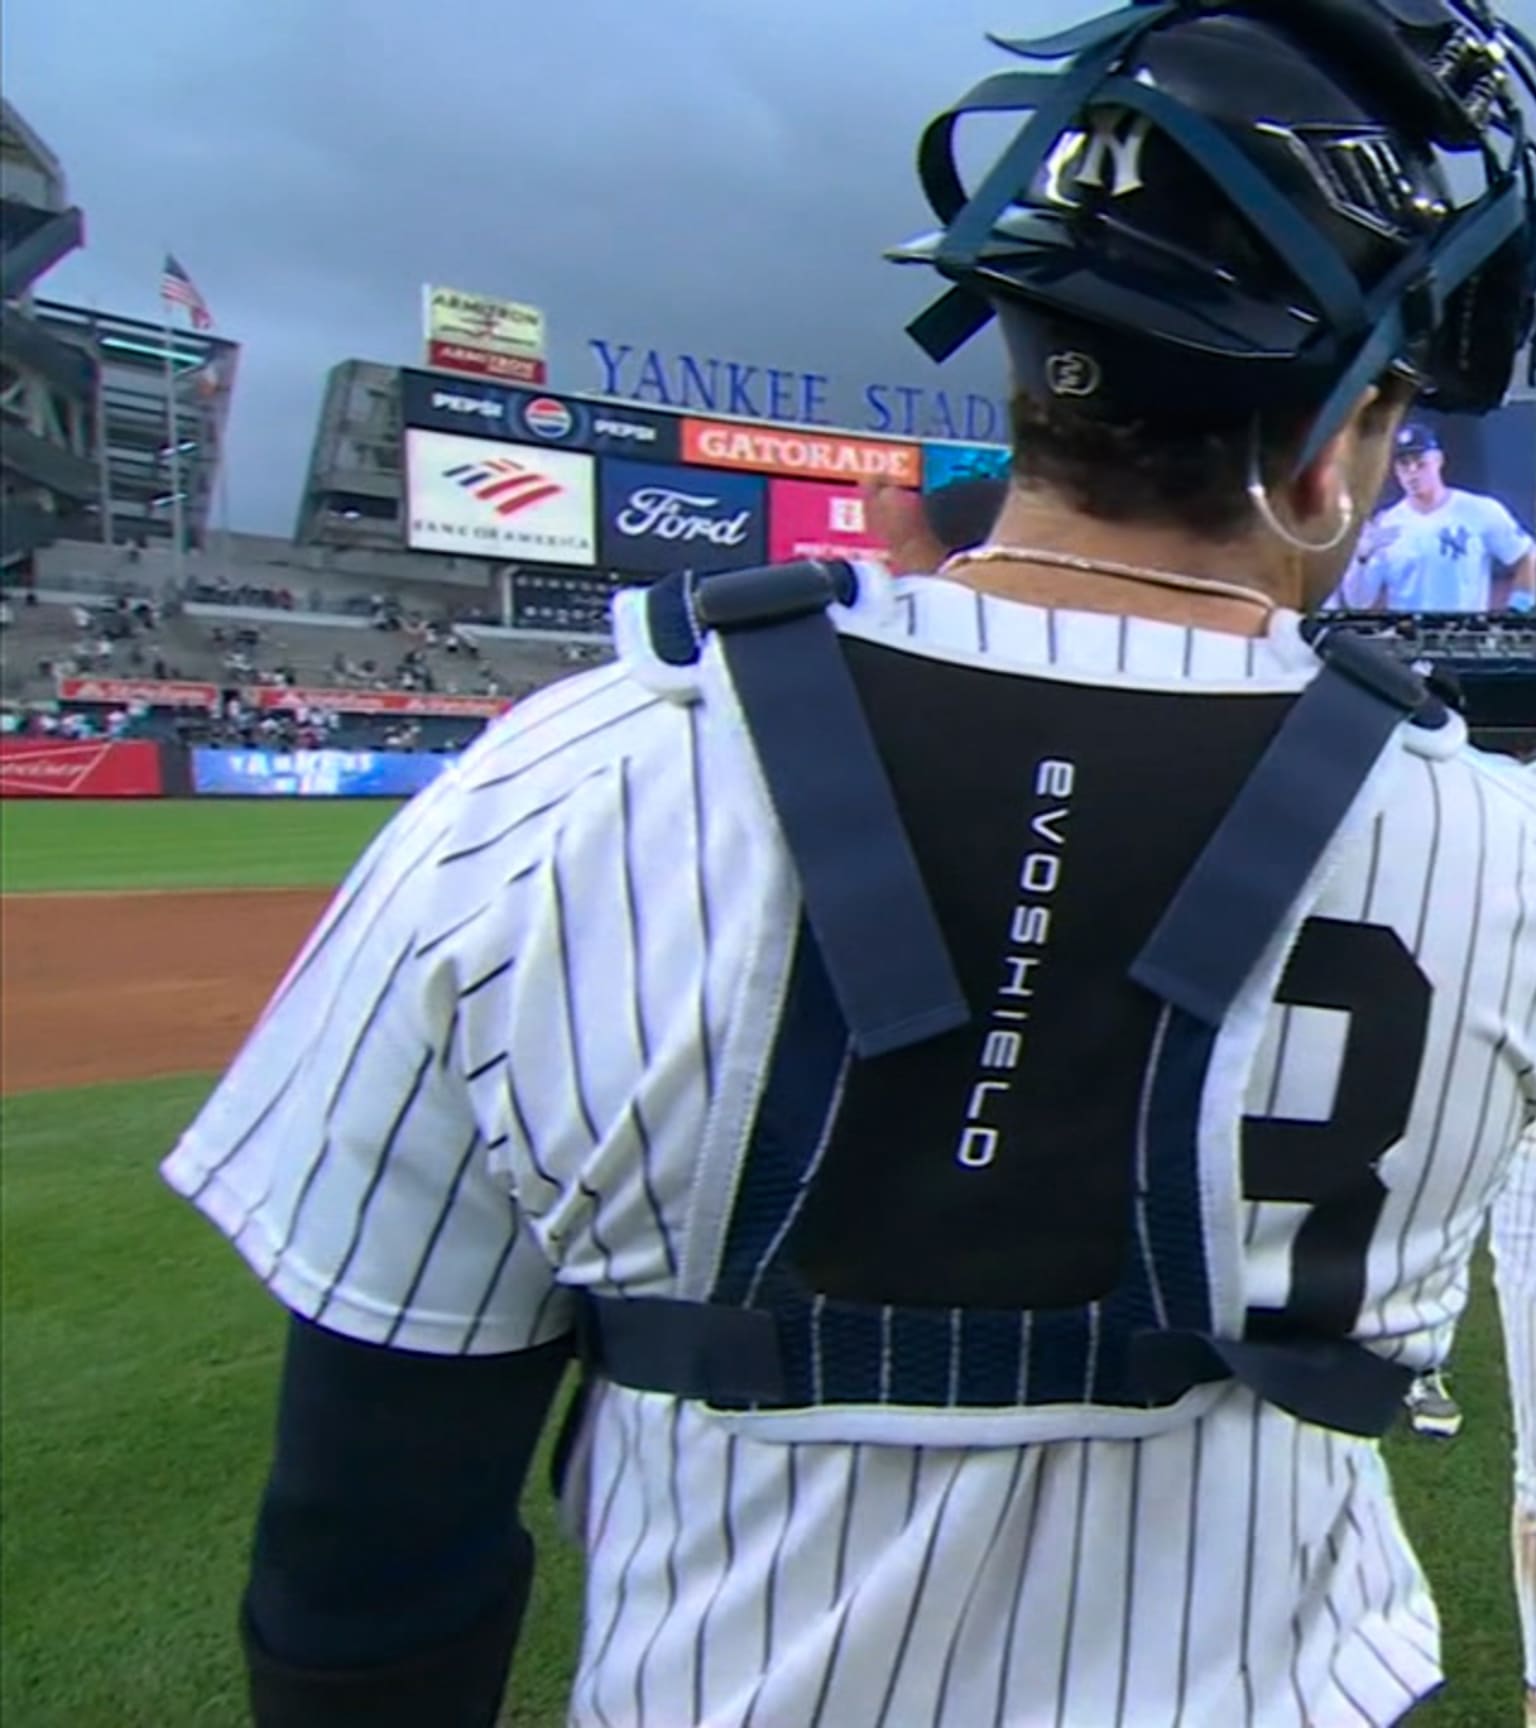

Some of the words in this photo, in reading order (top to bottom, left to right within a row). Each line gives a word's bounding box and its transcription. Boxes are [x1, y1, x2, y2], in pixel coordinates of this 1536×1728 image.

[431, 392, 504, 419] PEPSI
[589, 339, 831, 426] YANKEE
[866, 384, 998, 441] STAD
[593, 419, 657, 441] PEPSI
[697, 427, 912, 476] GATORADE
[503, 530, 591, 551] AMERICA
[616, 487, 751, 546] Ford
[955, 758, 1076, 1170] EVOSHIELD
